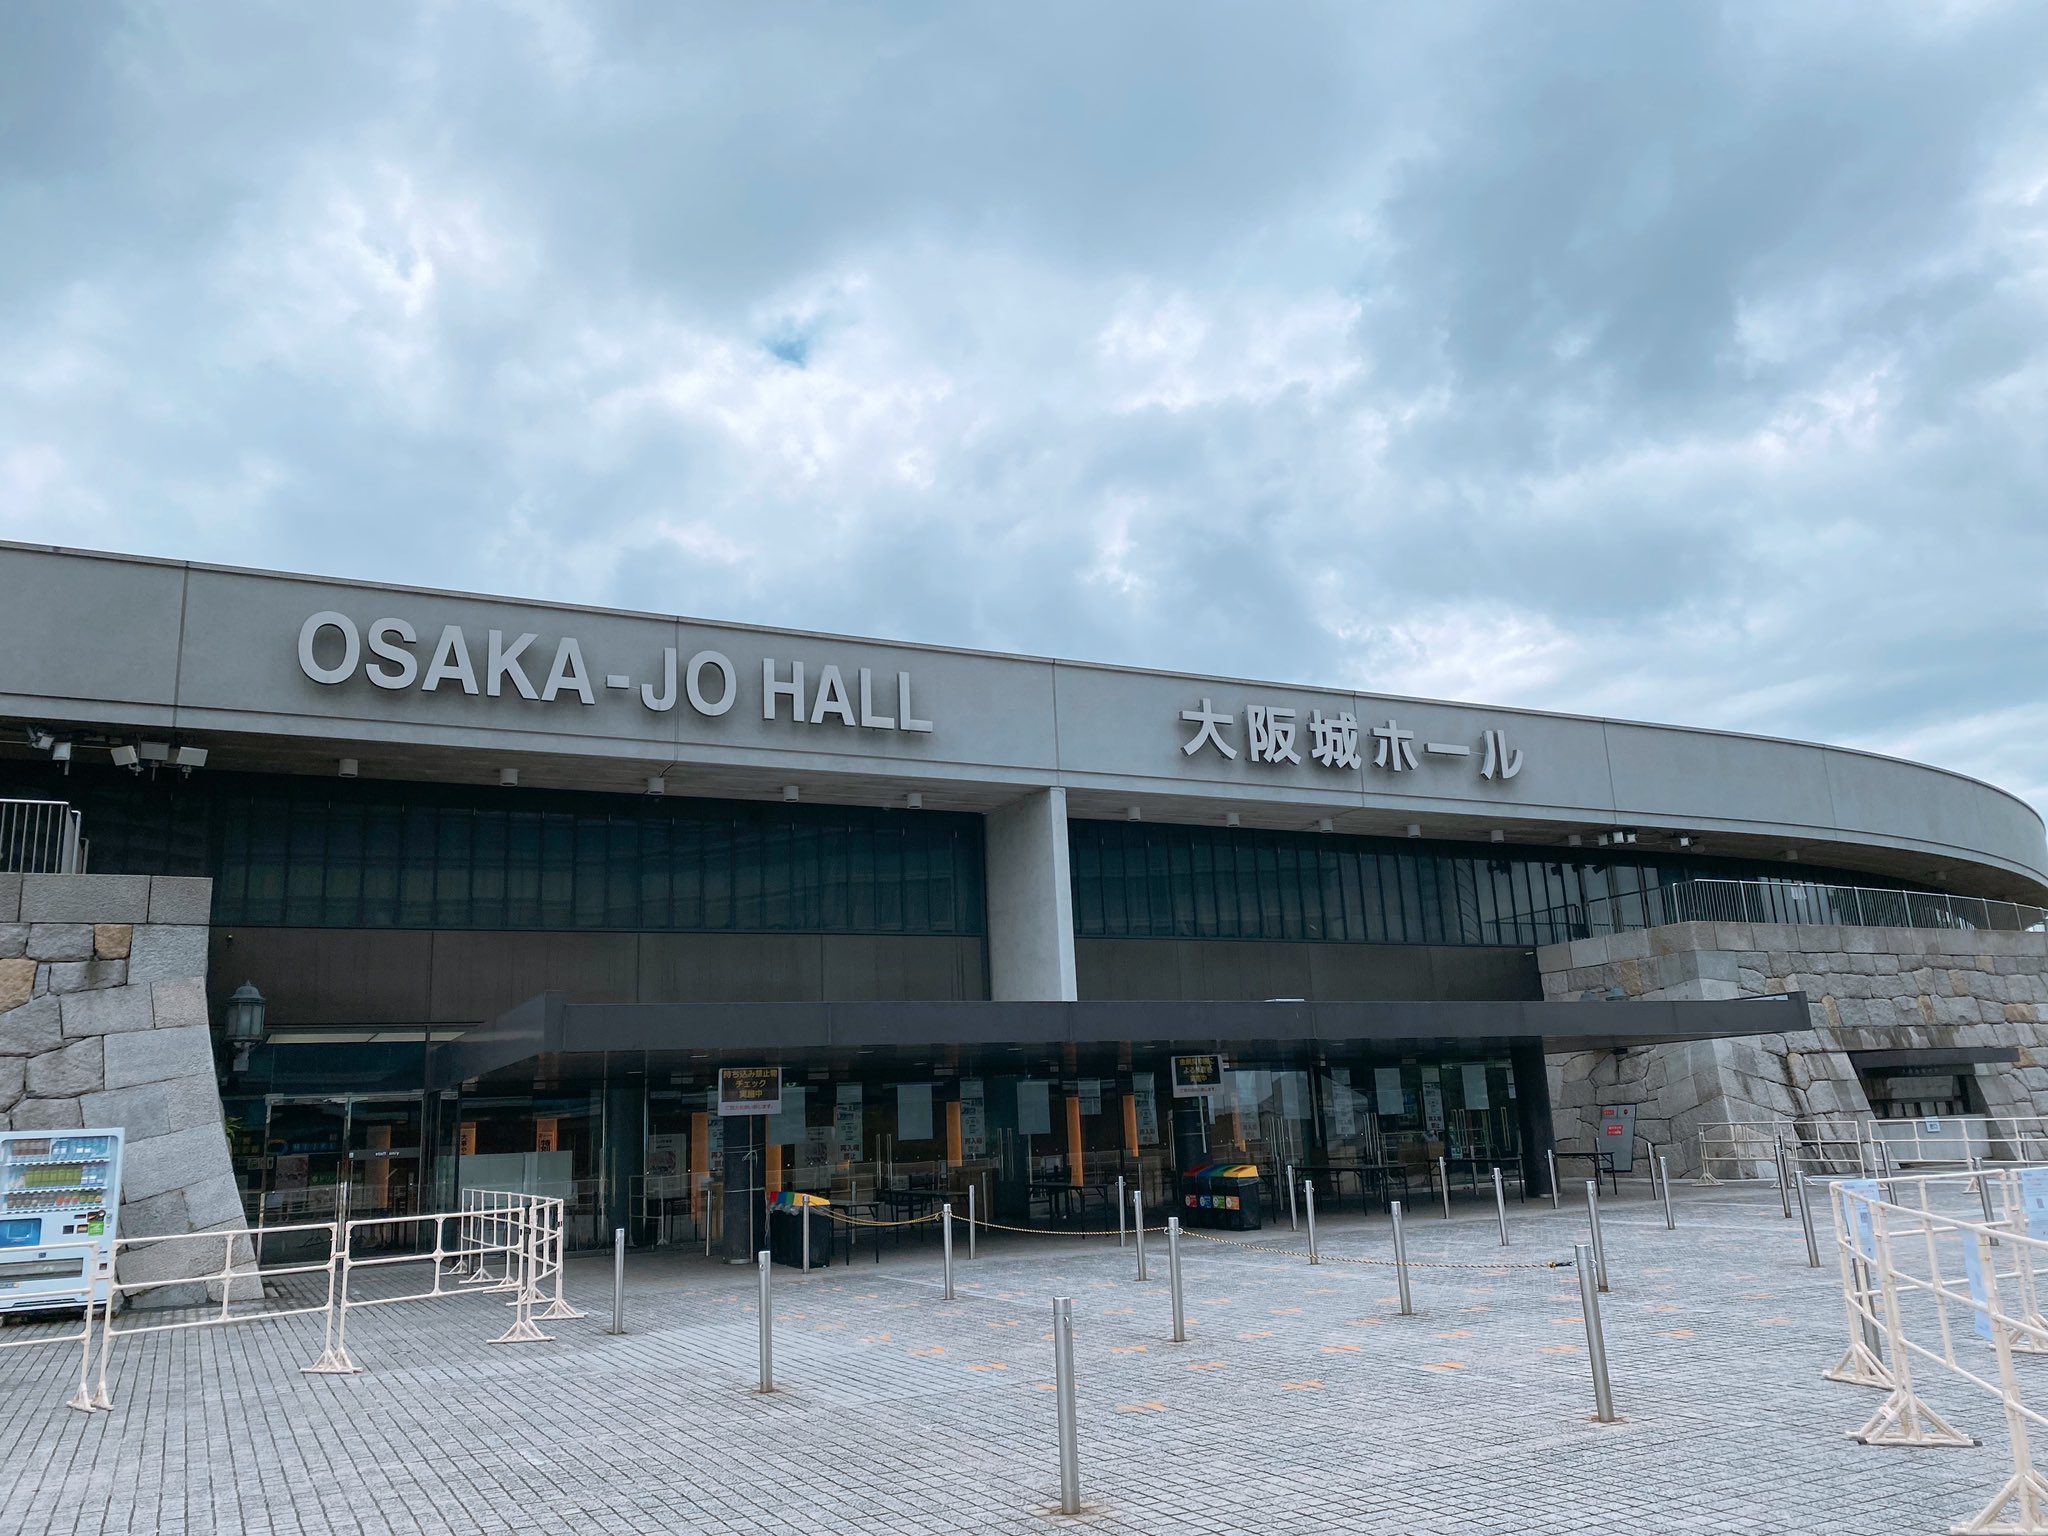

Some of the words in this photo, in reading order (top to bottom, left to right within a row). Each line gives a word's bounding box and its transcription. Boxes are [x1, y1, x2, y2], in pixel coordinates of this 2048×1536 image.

[298, 610, 738, 718] OSAKA-JO
[761, 657, 934, 734] HALL
[1179, 698, 1524, 781] 大阪城ホール
[735, 1079, 767, 1089] チェック
